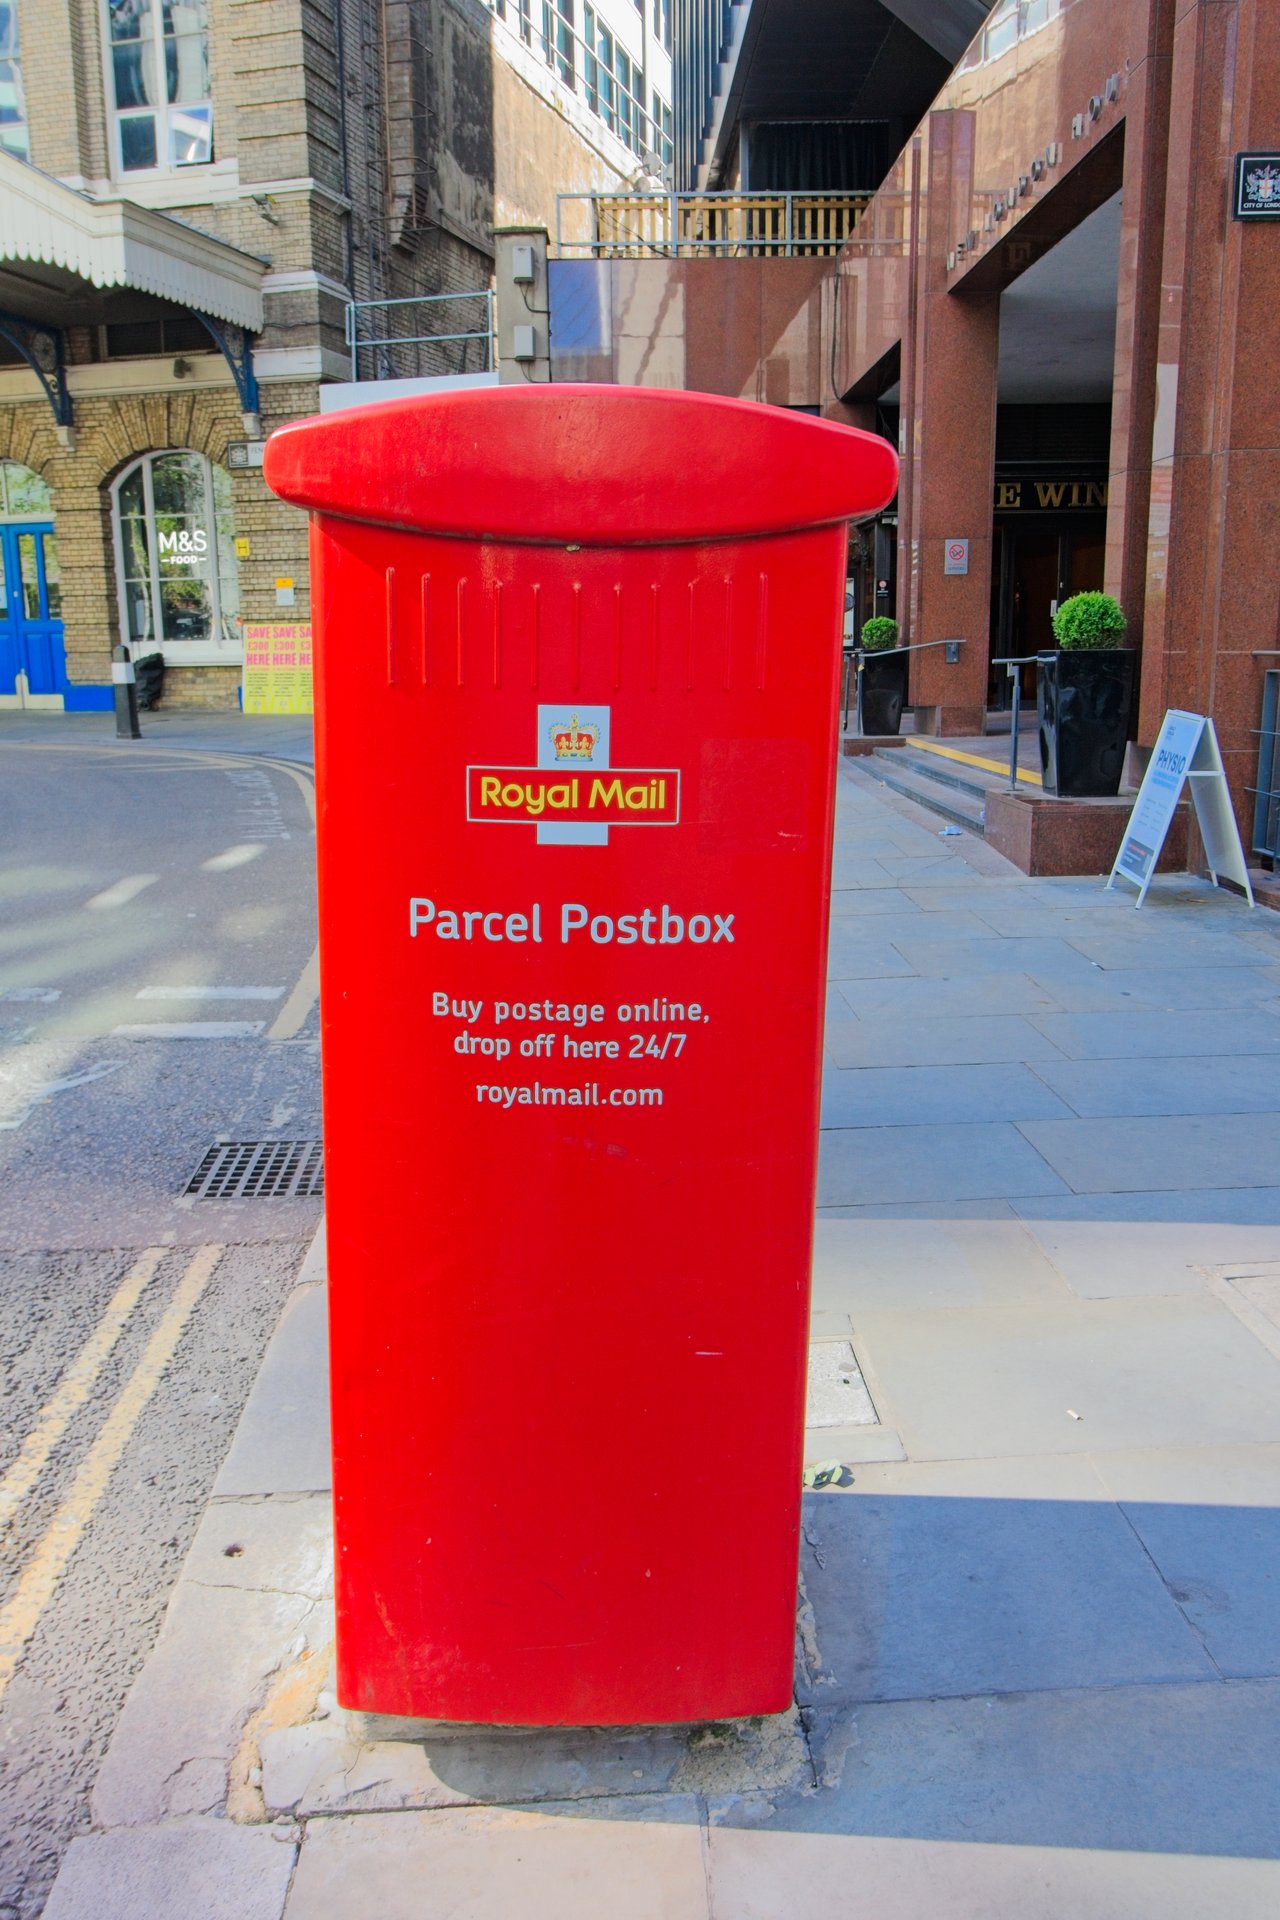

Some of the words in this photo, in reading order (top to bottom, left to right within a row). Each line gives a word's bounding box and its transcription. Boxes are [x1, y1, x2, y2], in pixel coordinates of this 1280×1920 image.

[158, 530, 207, 553] M&S
[170, 556, 198, 564] FOOD
[247, 626, 270, 639] SAVE
[273, 626, 296, 639] SAVE
[247, 653, 270, 666] HERE
[273, 653, 296, 666] HERE
[1156, 749, 1186, 775] PHYSIO
[481, 776, 579, 814] Royal
[588, 779, 666, 809] Mail
[409, 897, 542, 942] Parcel
[561, 903, 735, 944] Postbox
[432, 991, 483, 1023] Buy
[494, 999, 605, 1027] postage
[617, 997, 710, 1024] online,
[453, 1031, 511, 1060] drop
[519, 1033, 556, 1057] off
[563, 1034, 620, 1059] here
[628, 1032, 687, 1060] 24/7
[475, 1081, 663, 1109] royalmail.com
